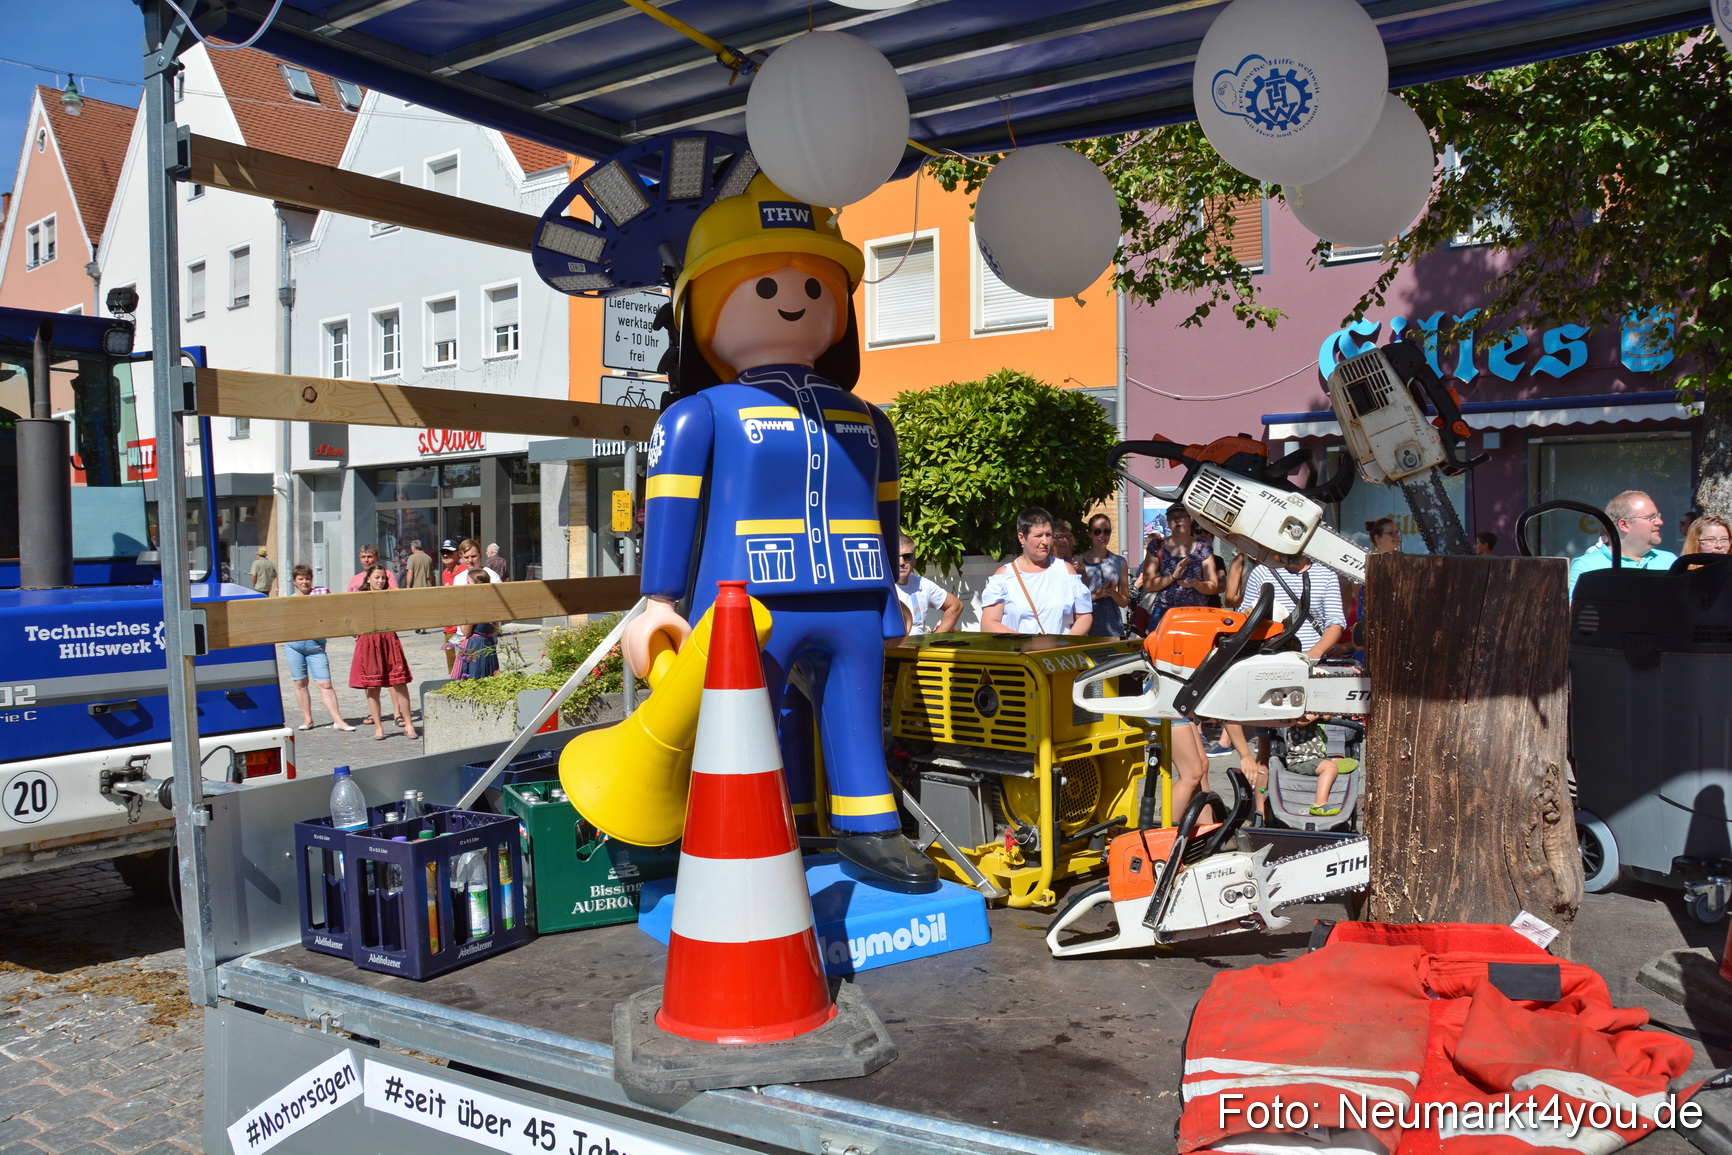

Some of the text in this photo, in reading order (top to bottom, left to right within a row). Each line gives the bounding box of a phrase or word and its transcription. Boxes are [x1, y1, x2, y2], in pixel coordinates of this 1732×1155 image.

[1268, 58, 1295, 67] Hilfe
[1298, 62, 1320, 94] weltweit
[1255, 128, 1274, 138] Herz
[762, 207, 810, 223] THW
[609, 297, 661, 315] Lieferverke
[617, 316, 653, 333] werktag
[615, 330, 621, 343] 6
[631, 332, 642, 346] 10
[644, 334, 660, 348] Uhr
[629, 349, 645, 363] frei
[1155, 458, 1166, 469] 31
[1259, 489, 1288, 510] STIHL
[25, 621, 150, 642] Technisches
[59, 639, 152, 660] Hilfswerk
[1041, 653, 1093, 672] 8 kVA
[1255, 670, 1296, 681] STIHL
[24, 710, 37, 721] C
[13, 778, 48, 816] 20
[1205, 867, 1236, 880] STIHL
[1325, 854, 1368, 878] STIH
[819, 912, 947, 969] laymobil
[246, 1064, 356, 1148] #Motorsägen
[384, 1075, 446, 1118] #seit
[457, 1098, 511, 1137] über
[523, 1117, 556, 1151] 45
